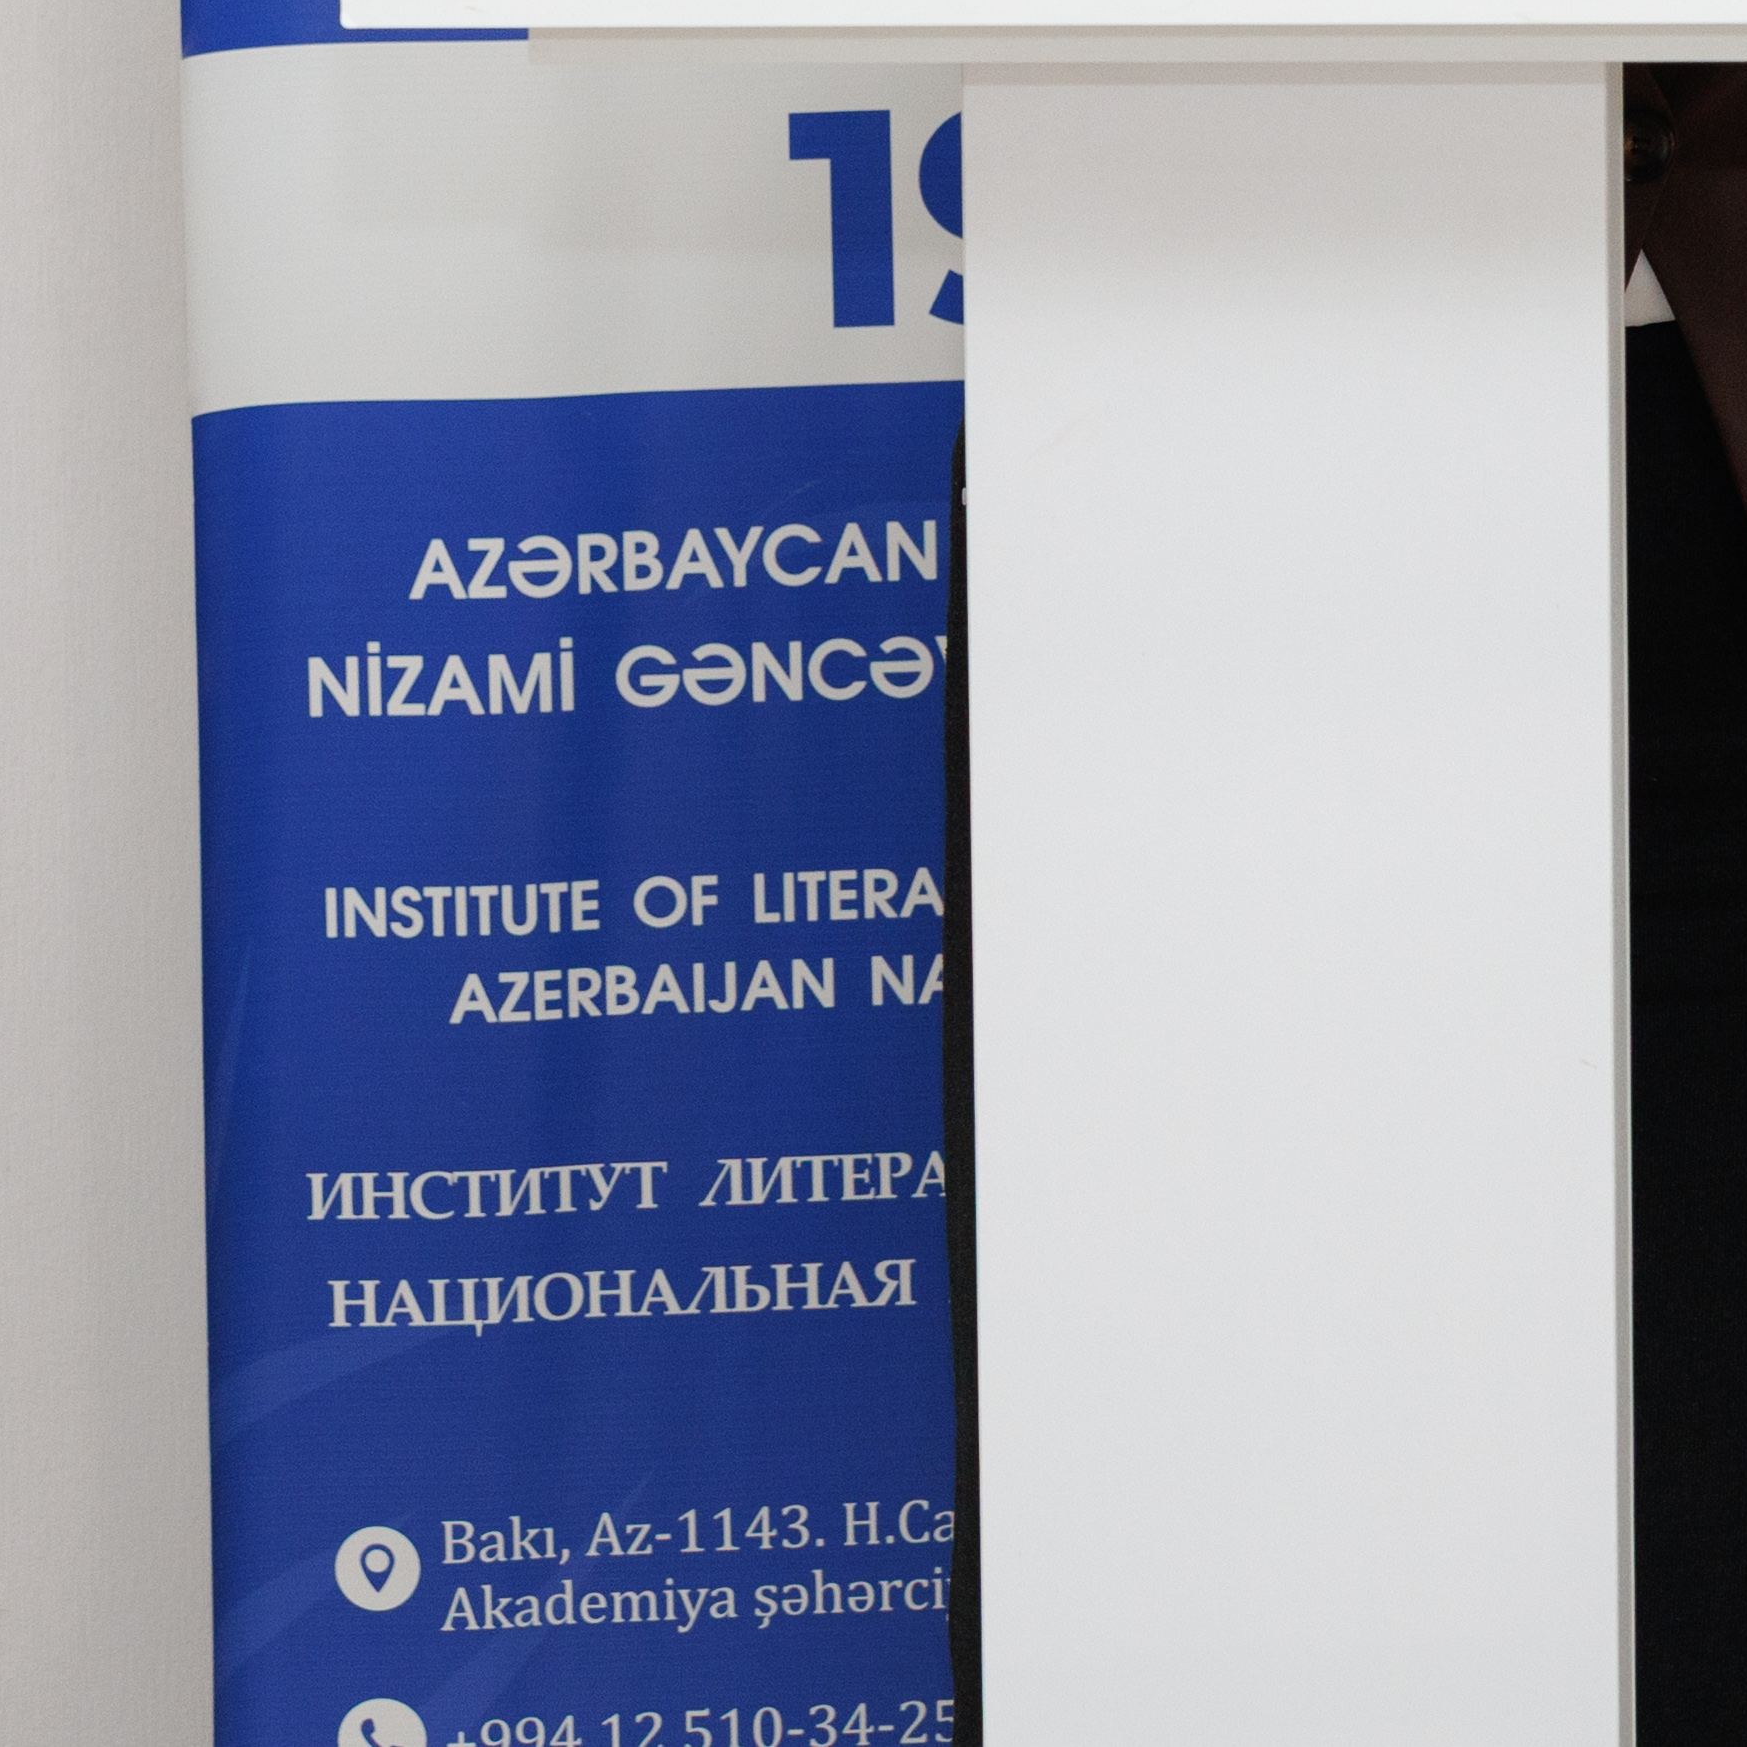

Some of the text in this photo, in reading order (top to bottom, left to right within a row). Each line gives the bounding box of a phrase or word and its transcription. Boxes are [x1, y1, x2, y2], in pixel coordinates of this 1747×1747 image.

[410, 520, 937, 599] AZƏRBAYCAN
[308, 637, 574, 717] NİZAMİ
[616, 636, 947, 707] GƏNCƏ
[326, 880, 599, 938] INSTITUTE
[634, 875, 718, 928] OF
[754, 868, 944, 923] LITERA
[450, 958, 834, 1024] AZERBAIJAN
[306, 1162, 667, 1220] ИНСТИТУТ
[328, 1259, 916, 1336] НАЦИОНАЛЬНАЯ
[442, 1516, 569, 1564] Bakı,
[586, 1505, 824, 1556] Az-1143.
[441, 1568, 951, 1632] Akademiya şəhərci
[602, 1713, 662, 1747] 12
